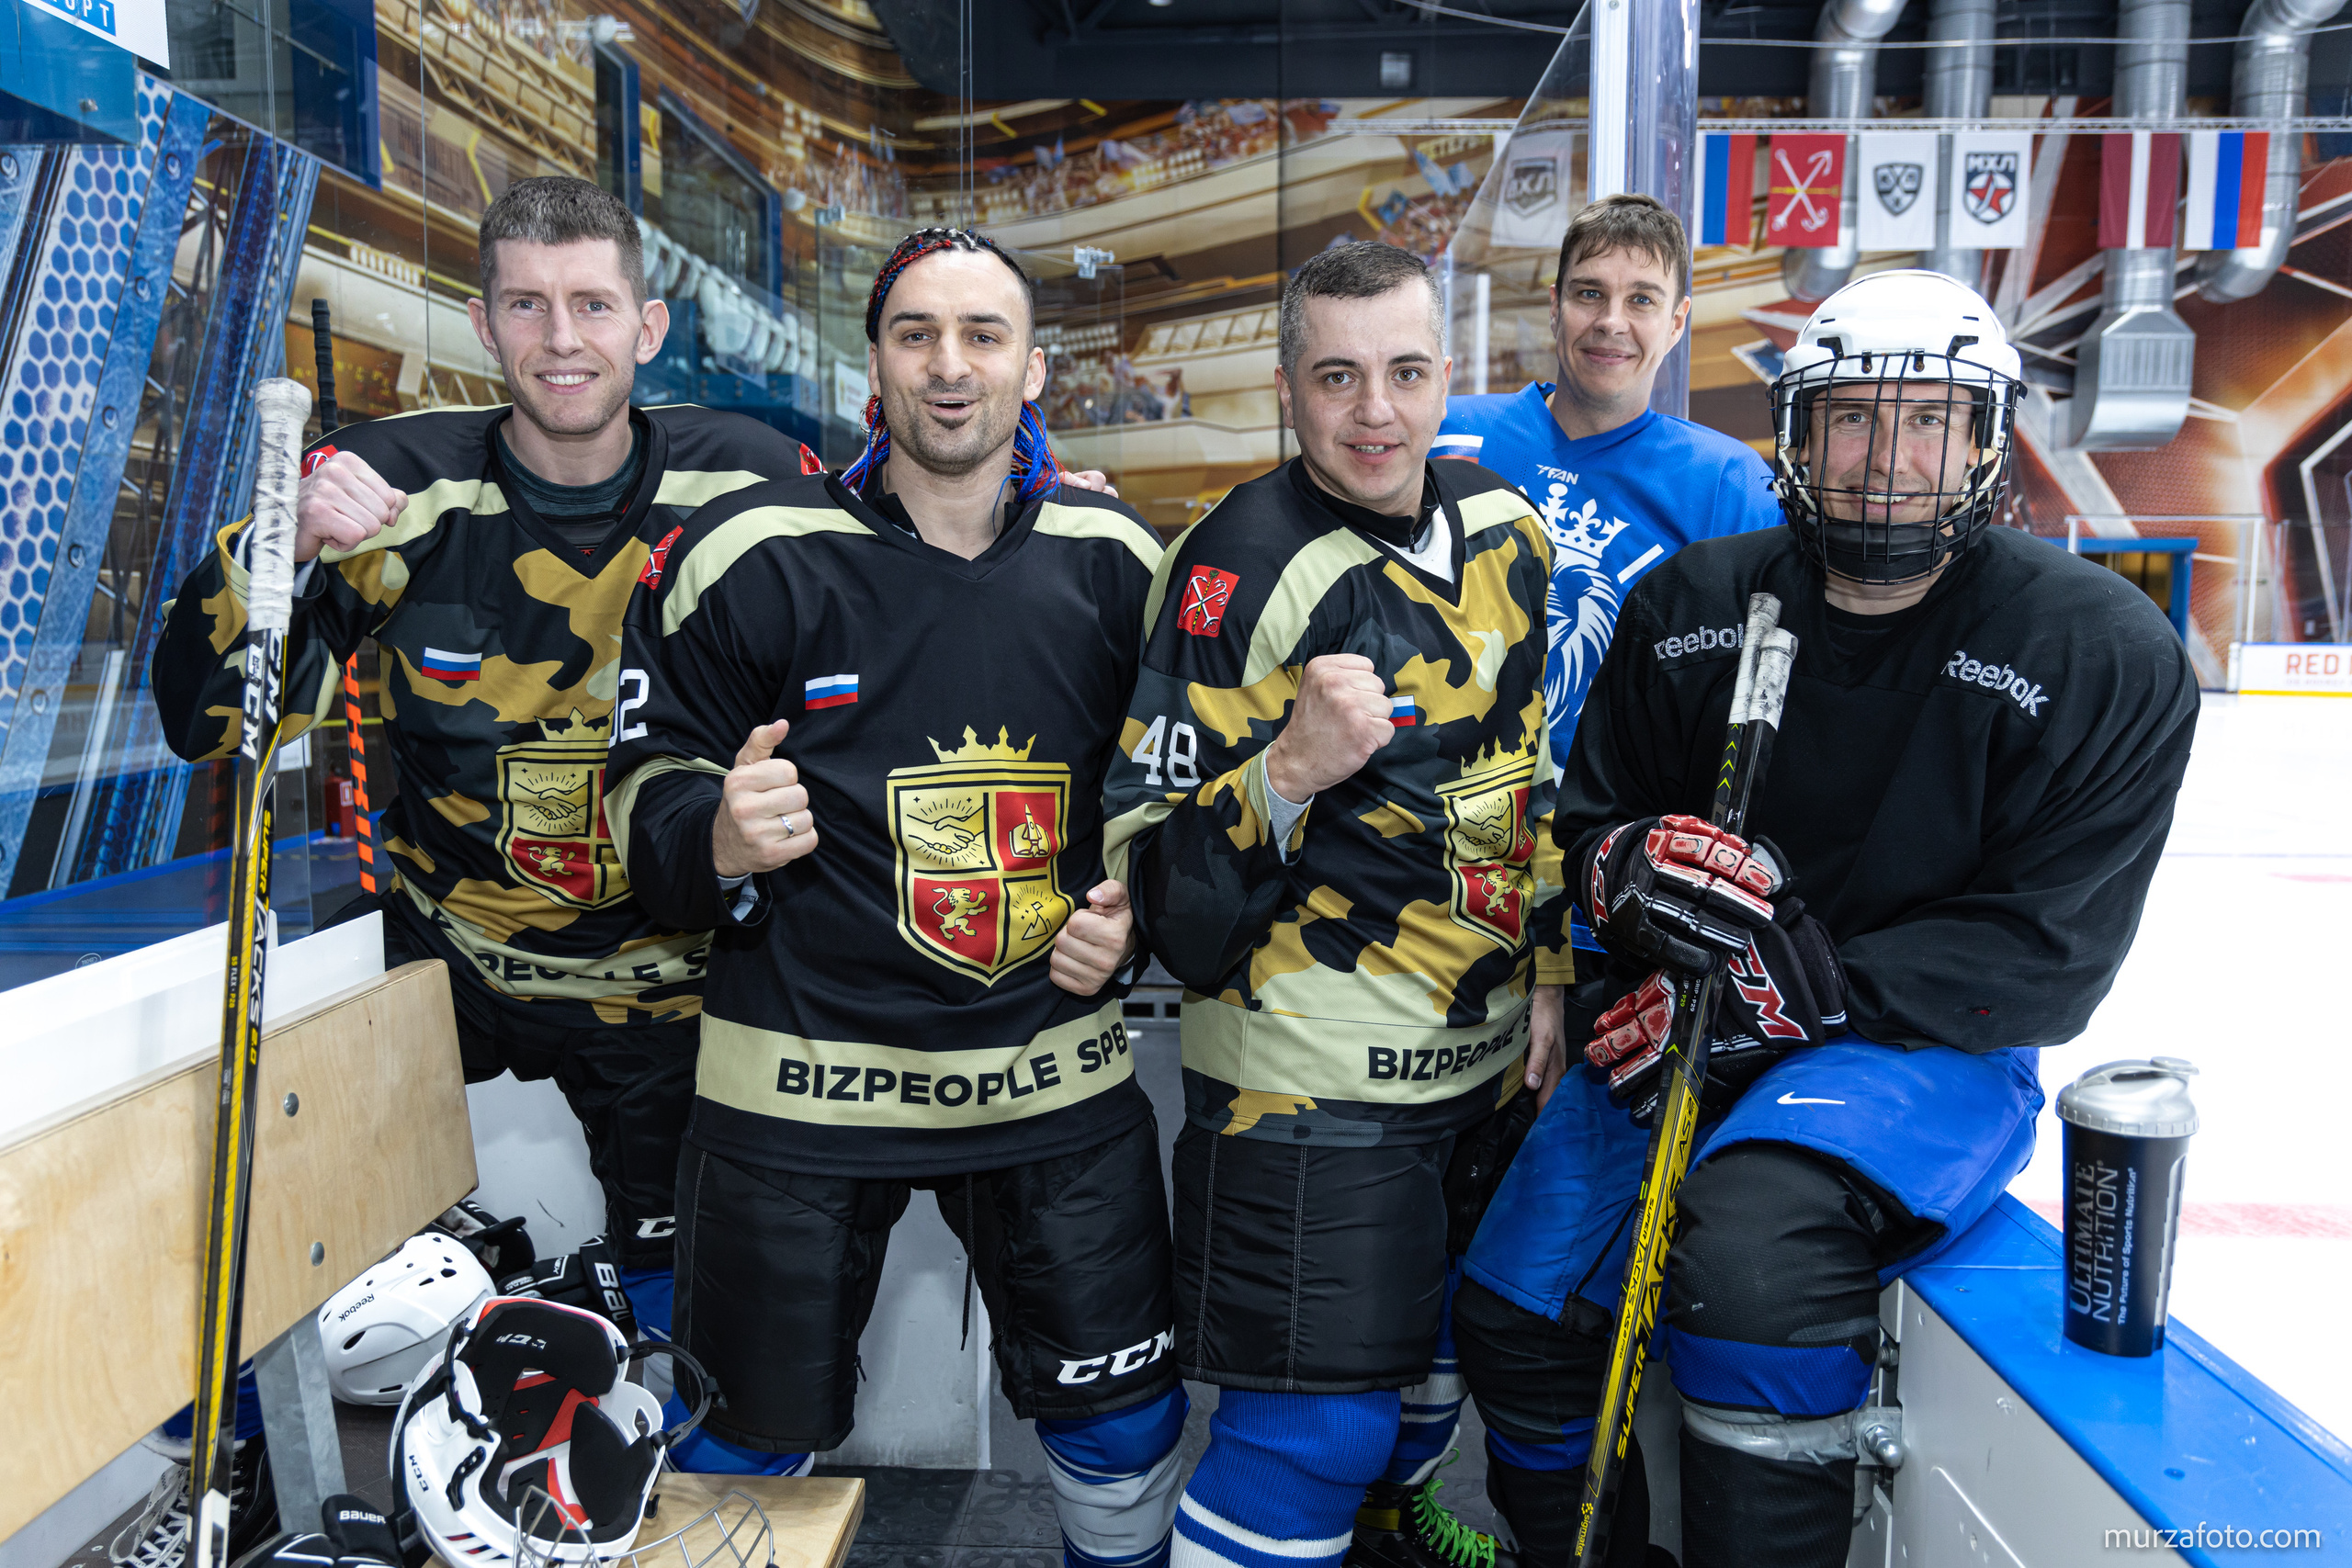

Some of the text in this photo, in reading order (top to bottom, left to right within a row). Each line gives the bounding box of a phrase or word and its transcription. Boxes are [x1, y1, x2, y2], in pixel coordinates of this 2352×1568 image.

[1968, 154, 2015, 173] МХЛ
[1940, 649, 2050, 716] Reebok
[2286, 653, 2339, 675] RED
[242, 643, 265, 761] CCM
[1131, 715, 1202, 787] 48
[250, 808, 271, 1066] SUPER TACKS 2.0
[776, 1021, 1128, 1107] BIZPEOPLE SPB
[1368, 1025, 1515, 1081] BIZPEOPLE
[1643, 1197, 1655, 1239] SUPER
[2069, 1162, 2096, 1315] ULTIMATE
[2122, 1219, 2133, 1256] Sports
[1627, 1239, 1647, 1306] TACKS
[2119, 1270, 2130, 1303] Future
[2122, 1256, 2131, 1268] of
[338, 1292, 375, 1322] Reebok
[2118, 1303, 2127, 1325] The
[1057, 1323, 1175, 1384] CCM
[1617, 1342, 1646, 1461] SUPER
[409, 1454, 429, 1493] CCM
[1576, 1514, 1590, 1558] sigmatex
